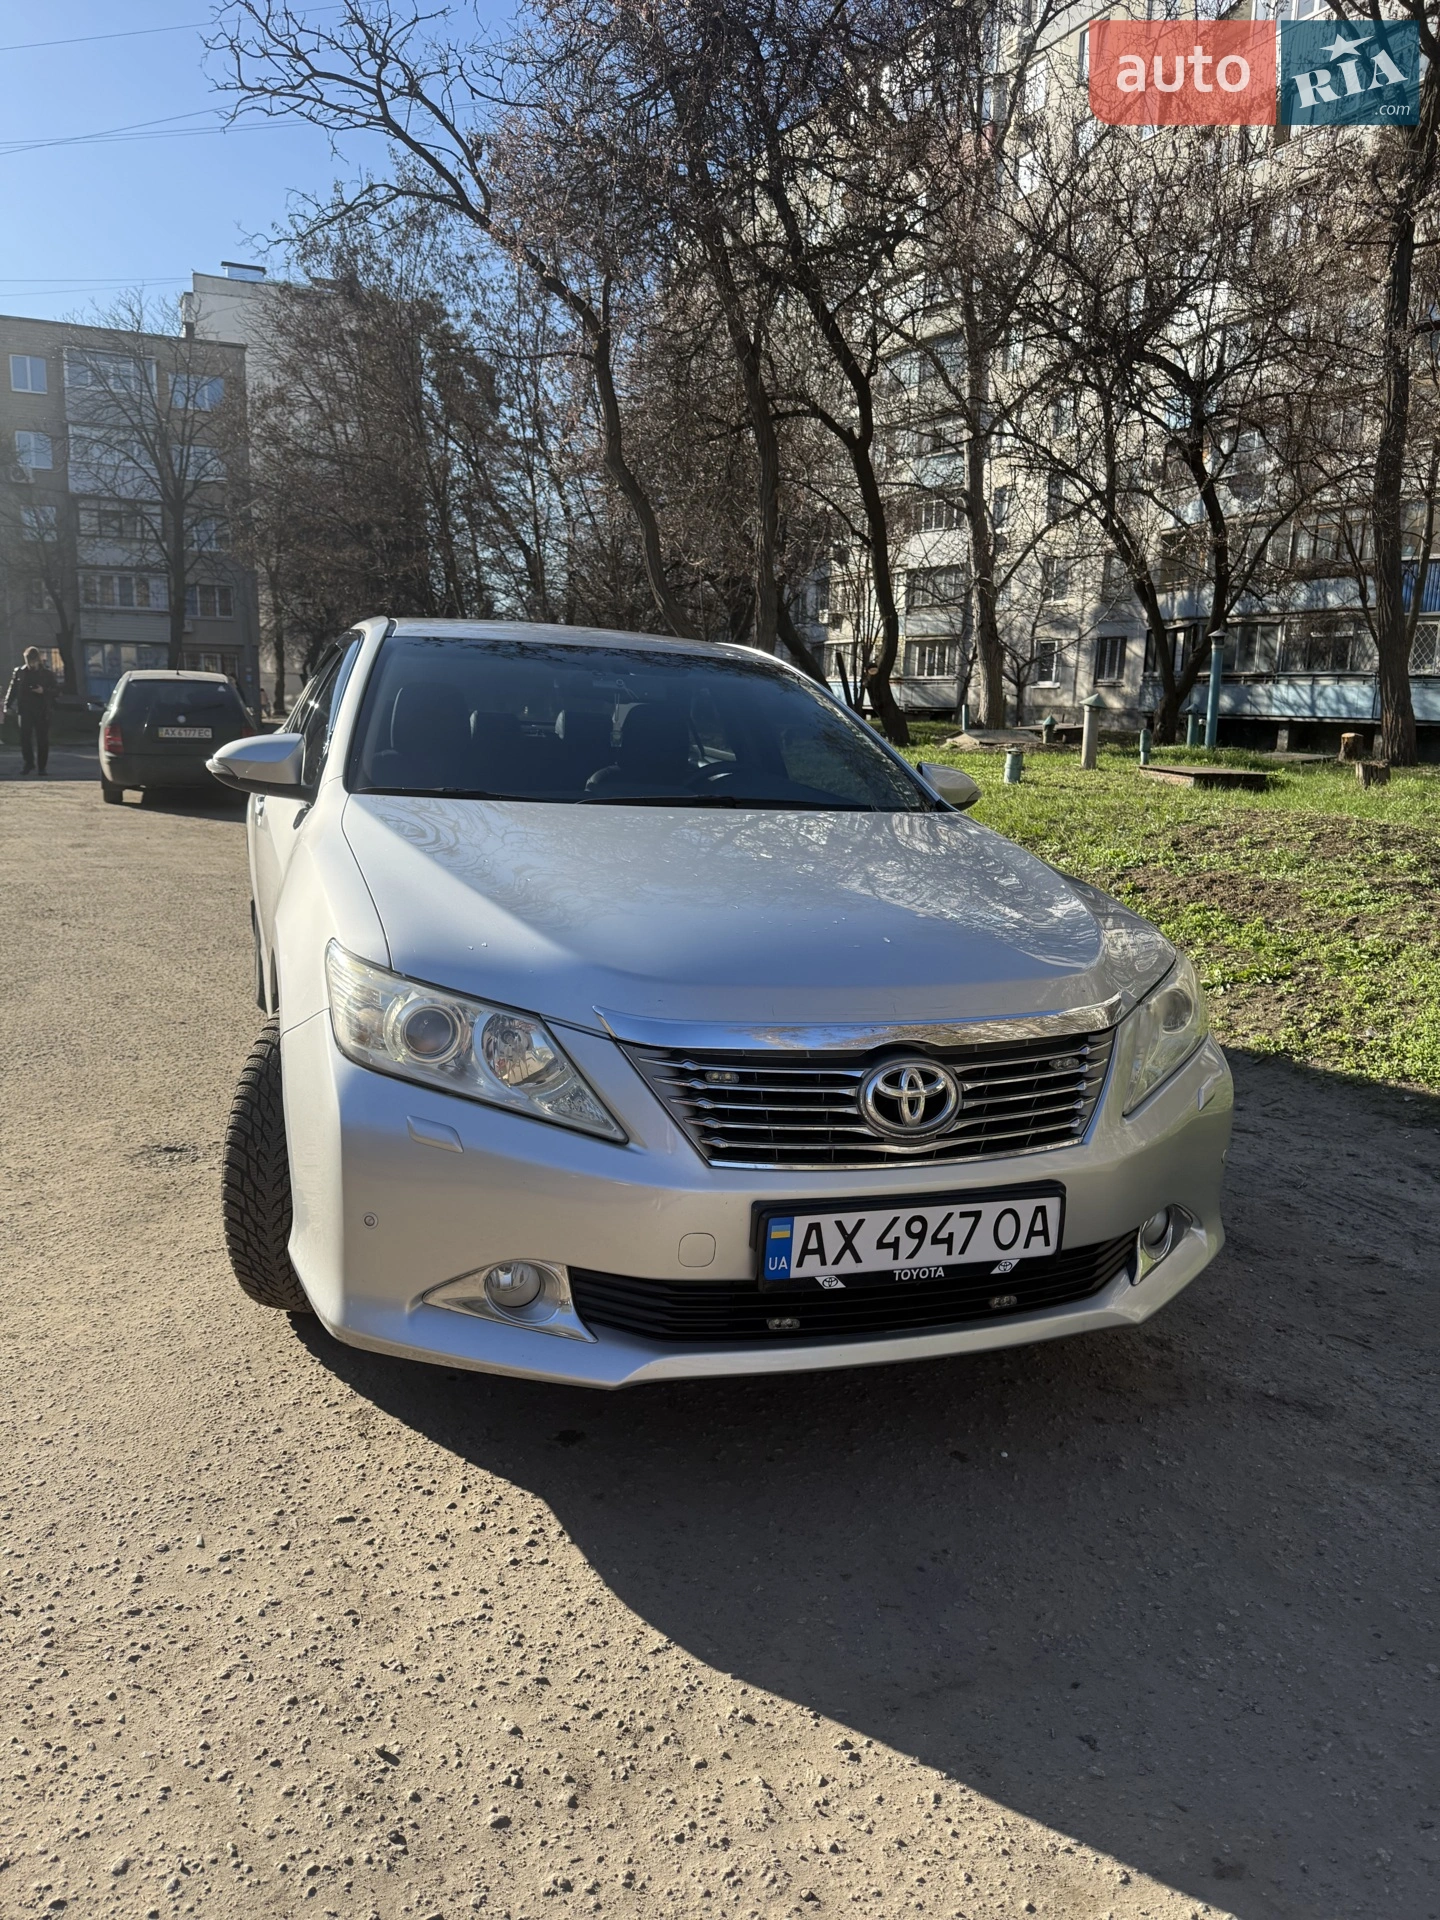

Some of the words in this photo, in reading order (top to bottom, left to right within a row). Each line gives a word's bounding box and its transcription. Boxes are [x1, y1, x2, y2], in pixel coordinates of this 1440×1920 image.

[164, 728, 176, 737] AX
[795, 1218, 866, 1268] AX
[876, 1210, 983, 1260] 4947
[992, 1205, 1051, 1251] OA
[768, 1256, 788, 1271] UA
[893, 1266, 945, 1281] TOYOTA
